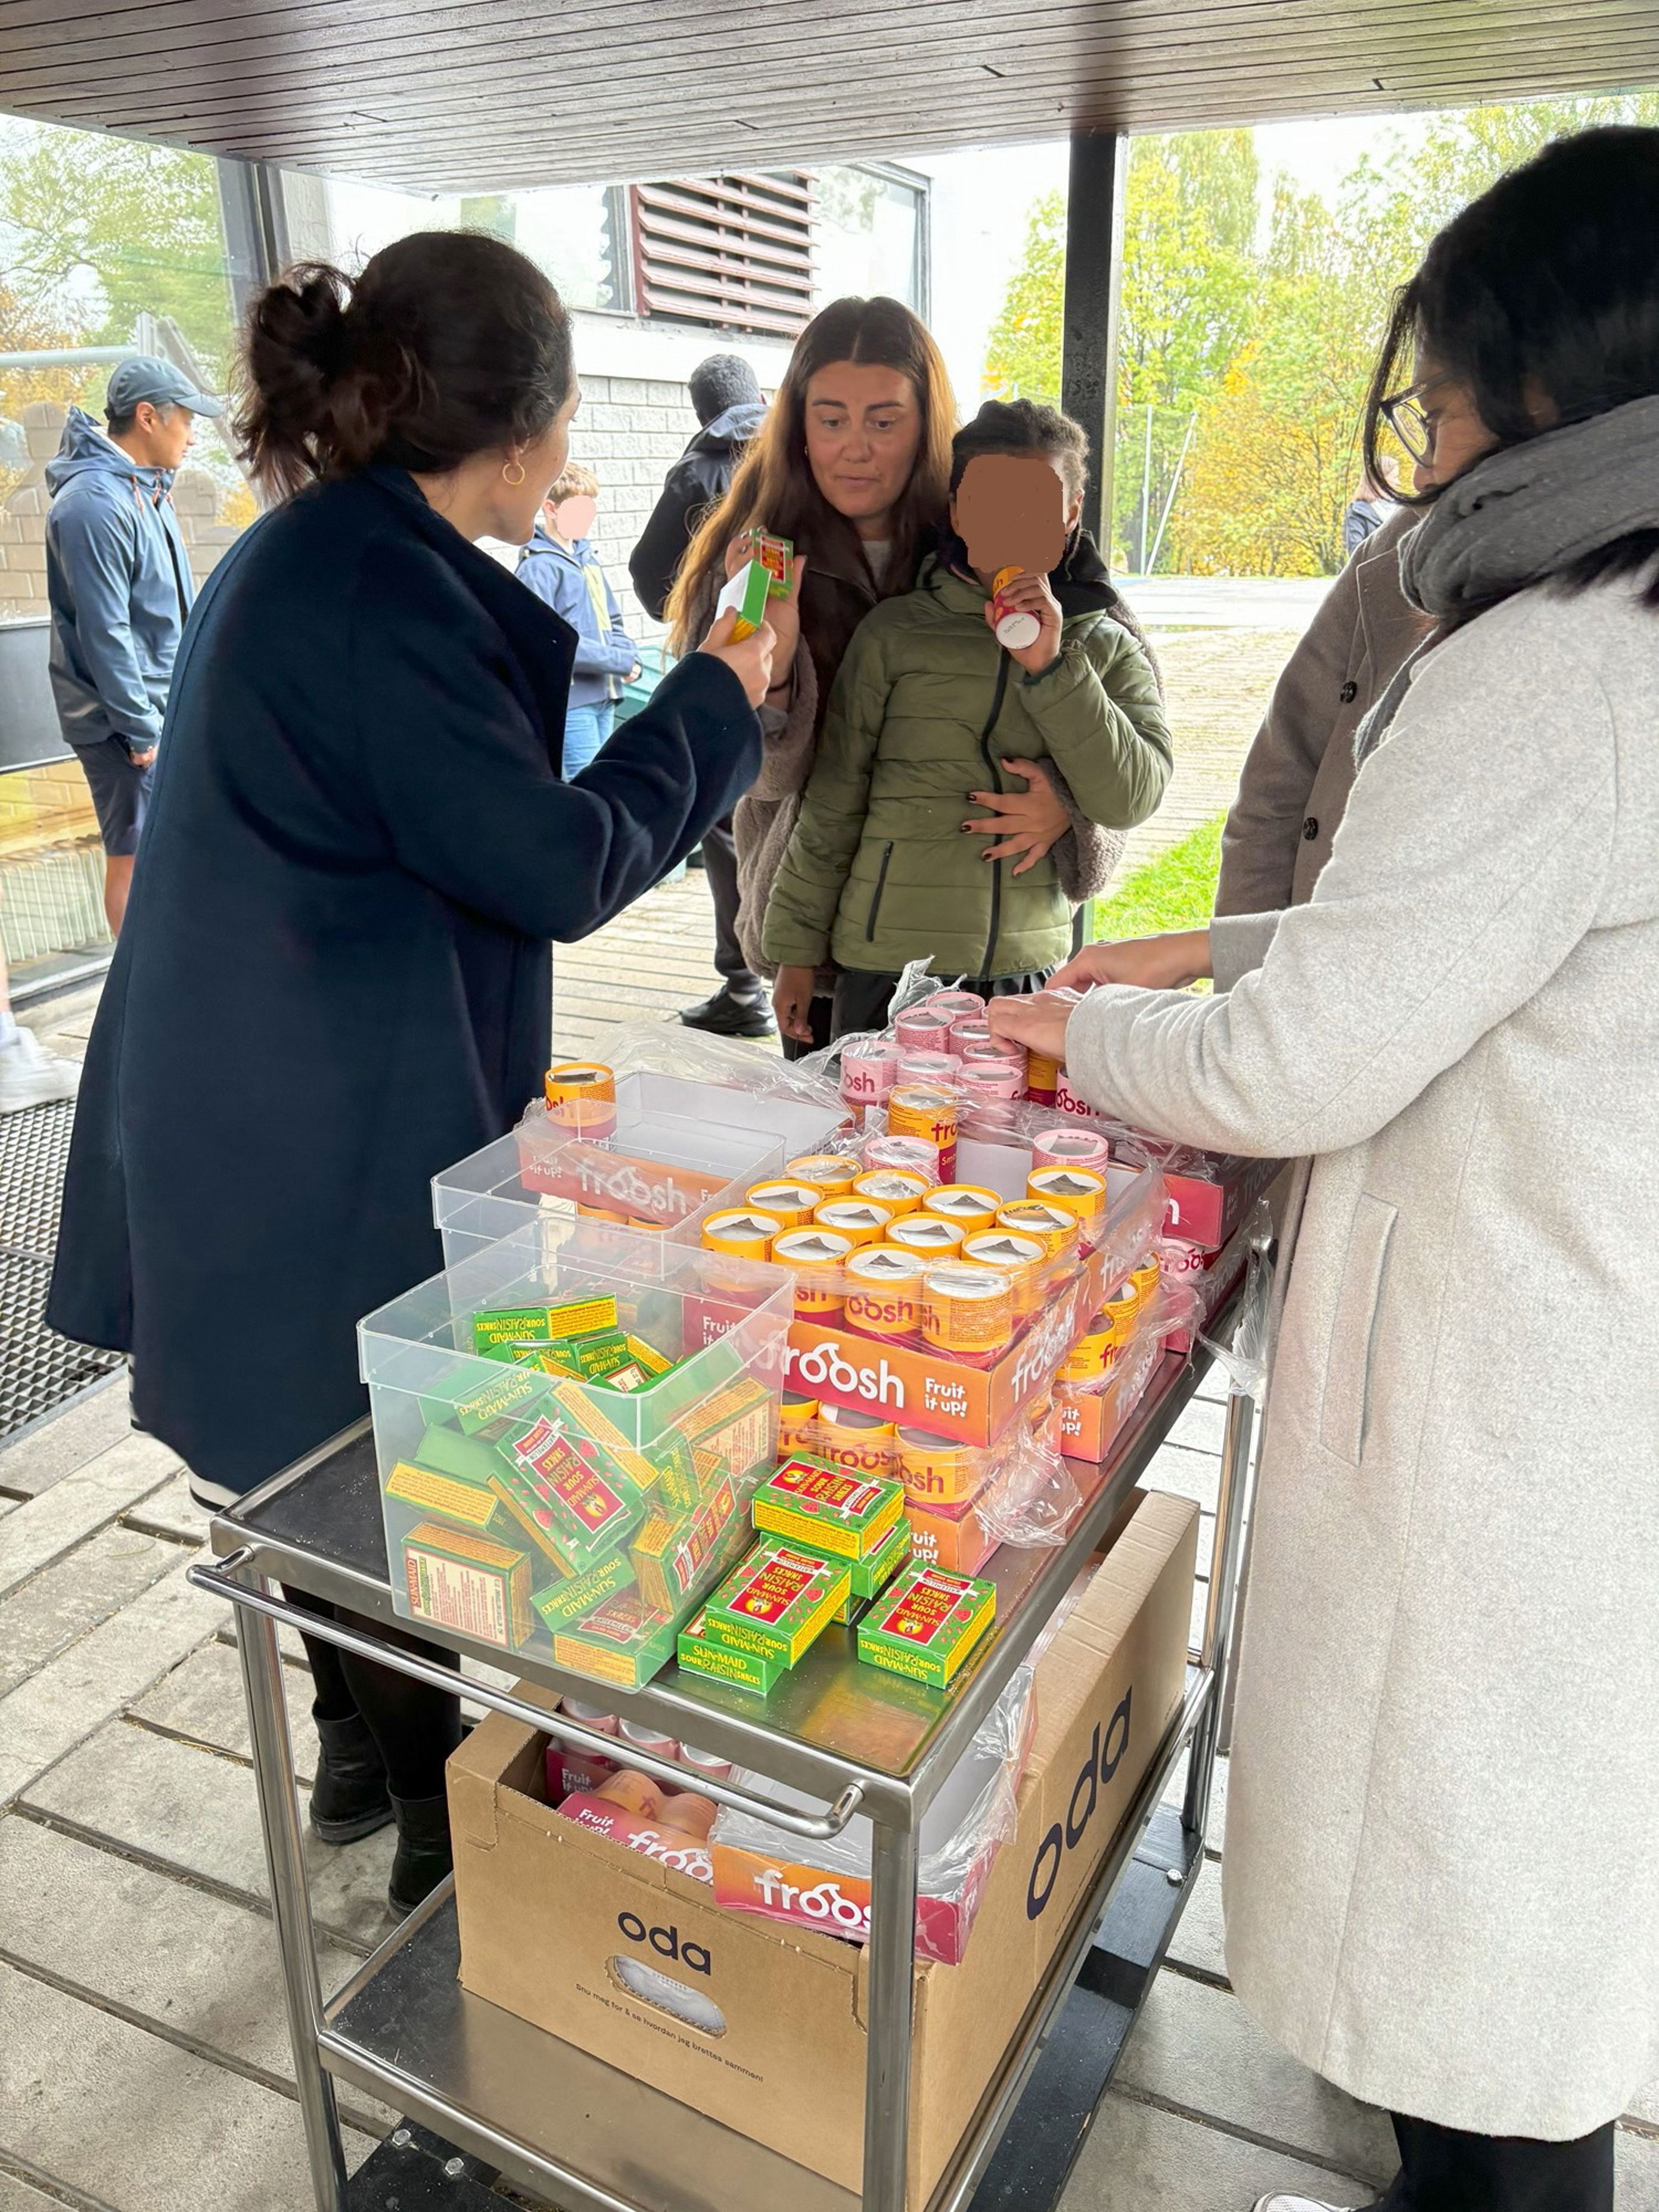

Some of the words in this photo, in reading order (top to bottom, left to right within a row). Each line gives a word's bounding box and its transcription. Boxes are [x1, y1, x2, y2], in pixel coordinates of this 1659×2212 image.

[525, 1318, 545, 1328] SOUR
[925, 1377, 966, 1399] Fruit
[925, 1394, 938, 1411] it
[941, 1401, 968, 1418] up!
[542, 1447, 566, 1470] SNACKS
[547, 1456, 580, 1486] RAISIN
[563, 1471, 585, 1491] SOUR
[567, 1474, 600, 1506] SUN-MAID
[598, 1558, 622, 1577] SOUR
[772, 1566, 803, 1580] SNACKS
[759, 1571, 805, 1592] RAISIN
[762, 1582, 788, 1595] SOUR
[541, 1594, 567, 1615] SNACKS
[562, 1577, 617, 1617] SUN-MAID
[745, 1586, 792, 1607] SUN-MAID
[907, 1592, 953, 1612] RAISIN
[920, 1587, 951, 1601] SNACKS
[896, 1607, 940, 1627] SUN-MAID
[911, 1603, 937, 1616] SOUR
[707, 1617, 732, 1633] SNACKS
[730, 1622, 767, 1646] RAISIN
[722, 1633, 775, 1660] SUN-MAID
[765, 1638, 788, 1652] SOUR
[860, 1640, 884, 1655] SNACKS
[883, 1645, 921, 1666] RAISIN
[693, 1645, 747, 1670] SUN-MAID
[874, 1655, 928, 1680] SUN-MAID
[918, 1660, 942, 1673] SOUR
[680, 1653, 703, 1667] SOUR
[702, 1658, 738, 1679] RAISIN
[737, 1670, 761, 1685] SNACKS
[562, 1767, 591, 1787] Fruit
[1026, 1685, 1133, 1921] oda
[579, 1808, 614, 1827] Fruit
[627, 1830, 713, 1885] froo
[618, 1911, 712, 1977] oda
[593, 1992, 610, 2007] meg
[611, 2000, 623, 2013] for
[632, 2013, 642, 2023] se
[643, 2016, 676, 2039] hvordan
[677, 2034, 691, 2048] jeg
[692, 2041, 723, 2063] brettes
